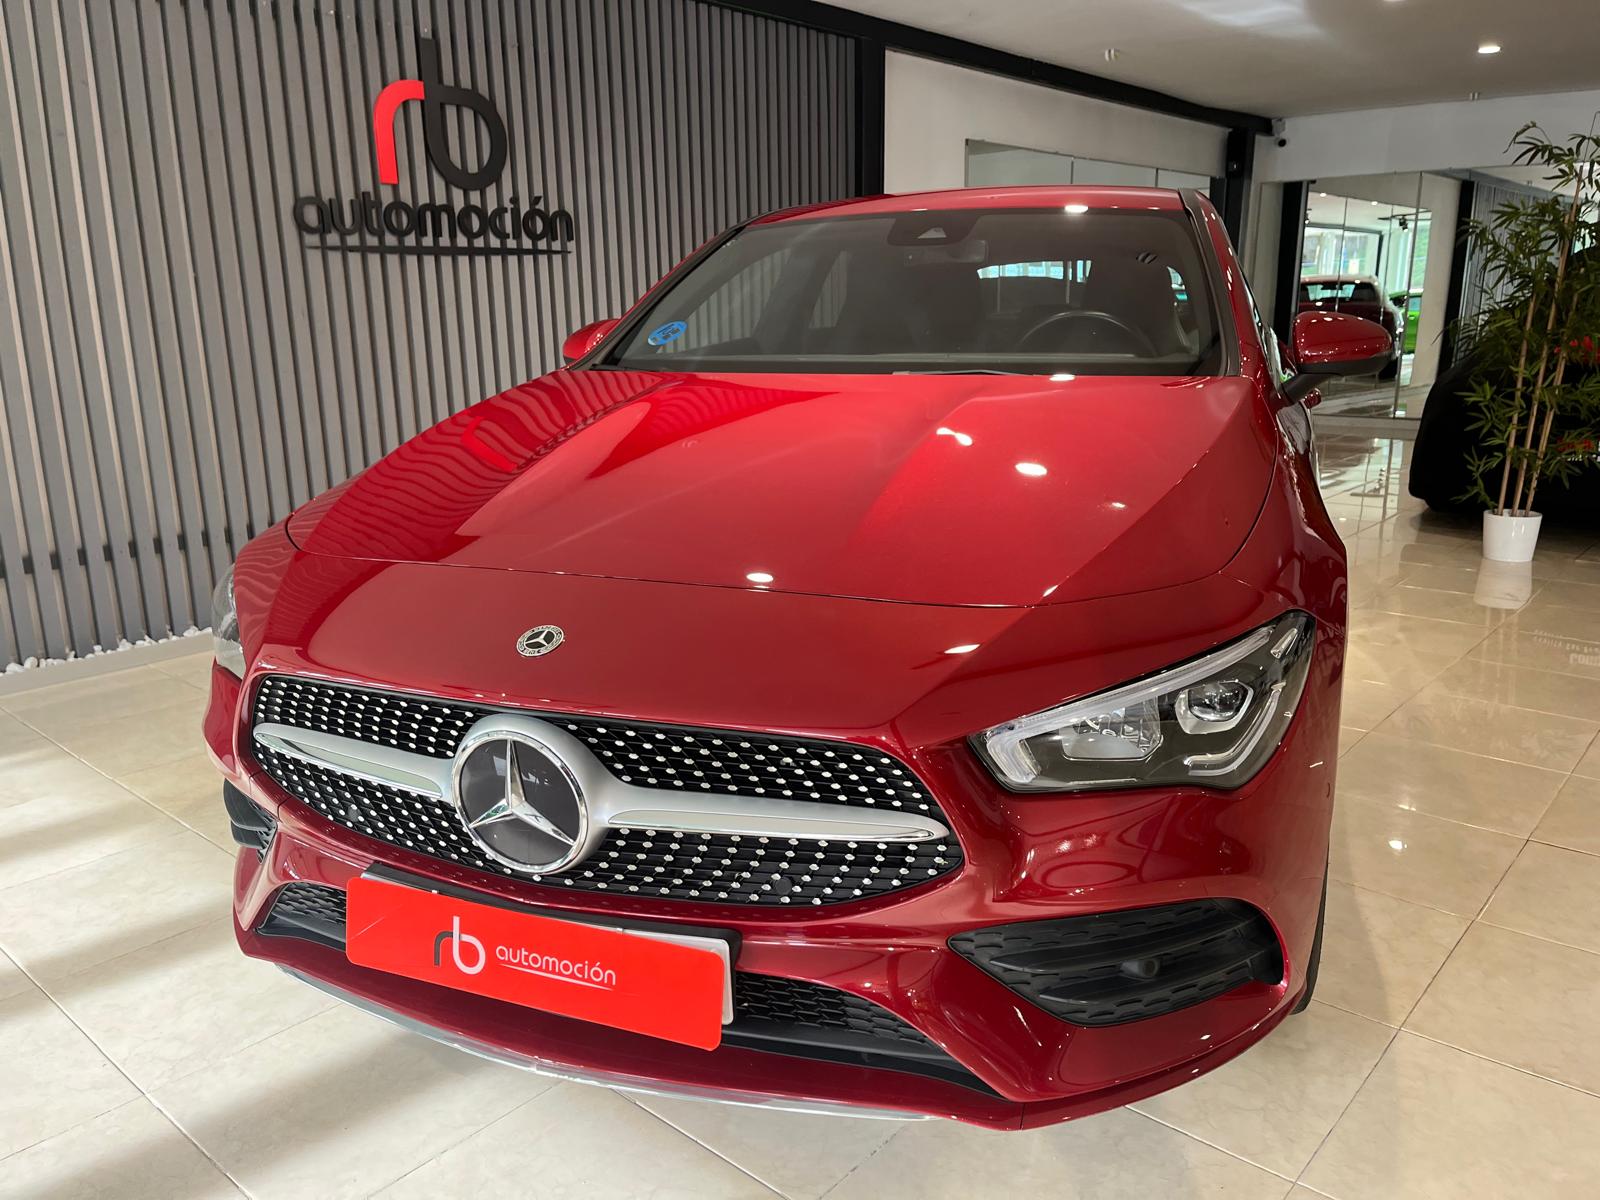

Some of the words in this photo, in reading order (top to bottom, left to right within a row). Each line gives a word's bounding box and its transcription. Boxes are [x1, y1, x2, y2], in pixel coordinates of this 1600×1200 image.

[373, 38, 507, 191] rb
[293, 191, 574, 242] automoción
[434, 916, 486, 975] rb
[496, 945, 616, 985] automoción
